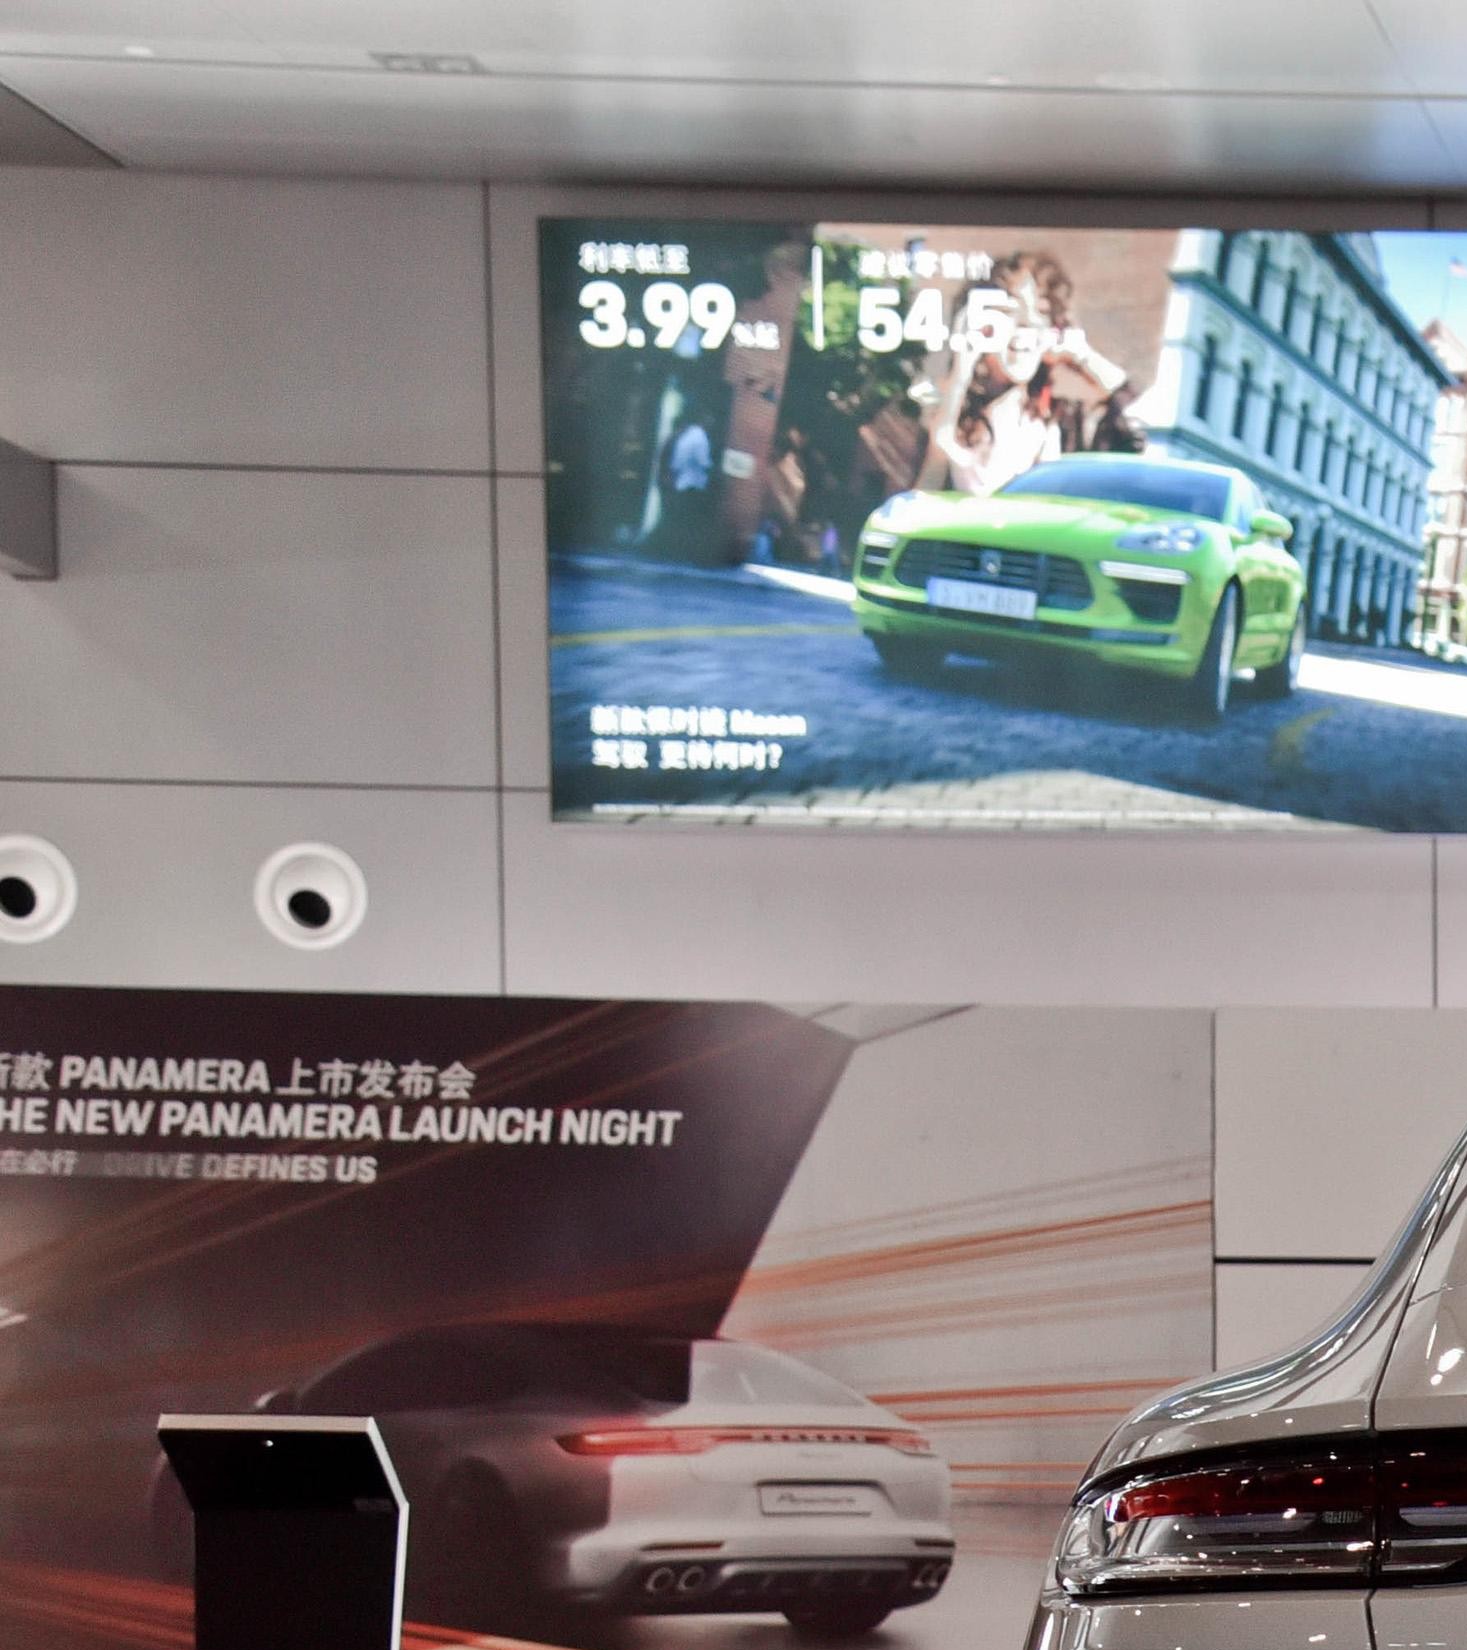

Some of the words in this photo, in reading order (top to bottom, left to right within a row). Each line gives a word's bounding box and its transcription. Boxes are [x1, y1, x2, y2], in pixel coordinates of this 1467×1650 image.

[59, 1054, 270, 1095] PANAMERA
[274, 1056, 477, 1100] 上市发布会
[55, 1097, 156, 1137] NEW
[158, 1100, 383, 1141] PANAMERA
[389, 1104, 554, 1145] LAUNCH
[560, 1108, 684, 1147] NIGHT
[201, 1152, 328, 1183] DEFINES
[334, 1155, 379, 1184] US
